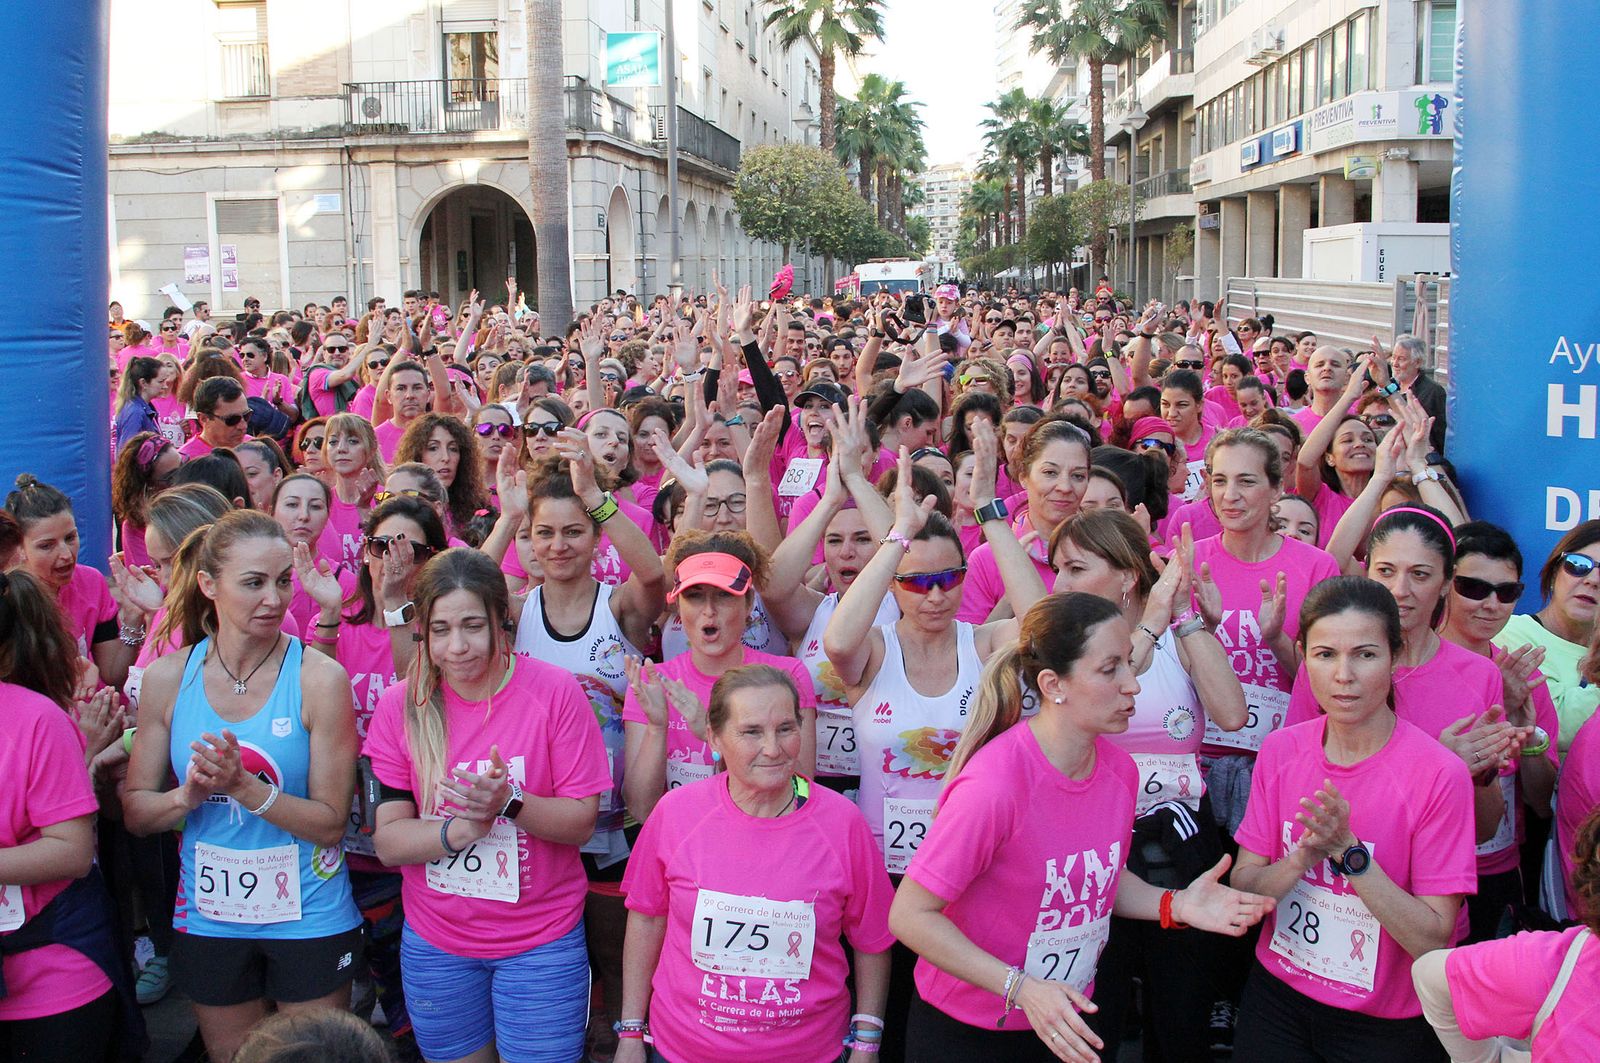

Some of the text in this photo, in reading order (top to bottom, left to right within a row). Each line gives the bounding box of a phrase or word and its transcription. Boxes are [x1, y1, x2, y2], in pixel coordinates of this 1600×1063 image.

[1313, 100, 1354, 129] PREVENTIVA
[1358, 118, 1396, 126] PREVENTIVA
[1228, 648, 1279, 677] OR
[901, 806, 932, 815] Carrera
[489, 832, 512, 842] Mujer
[210, 851, 240, 865] Carrera
[242, 857, 254, 865] de
[256, 856, 266, 865] la
[268, 853, 294, 863] Mujer
[200, 865, 259, 900] 519
[716, 901, 754, 915] Carrera
[757, 907, 769, 917] de
[772, 910, 781, 919] la
[784, 911, 810, 922] Mujer
[1318, 899, 1330, 911] de
[1333, 901, 1342, 913] la
[1345, 906, 1375, 922] Mujer
[703, 917, 770, 951] 175
[1288, 901, 1320, 945] 28
[1358, 918, 1374, 929] 2019
[1048, 935, 1079, 947] Carrera
[1081, 931, 1090, 940] de
[1042, 948, 1081, 982] 27
[701, 974, 801, 1006] ELLAS
[698, 998, 805, 1018] IX Carrera de la Mujer
